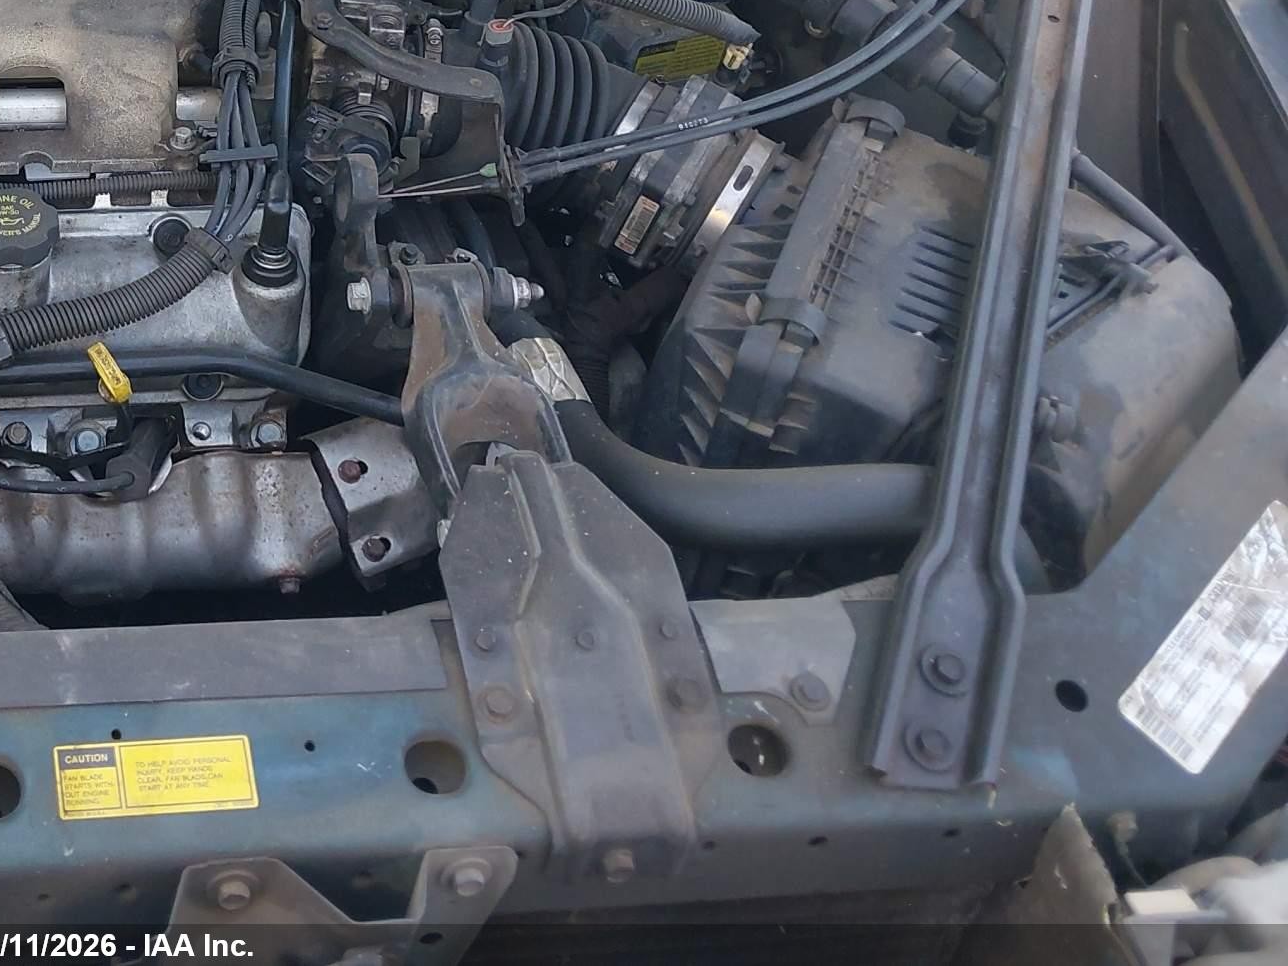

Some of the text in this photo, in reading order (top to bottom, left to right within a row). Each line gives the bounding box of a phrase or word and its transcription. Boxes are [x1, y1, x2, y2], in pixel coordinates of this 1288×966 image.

[19, 198, 35, 210] OIL
[21, 212, 41, 234] MANUAL
[64, 754, 109, 764] CAUTION
[135, 761, 146, 769] TO
[148, 760, 166, 768] HELP
[63, 774, 78, 782] FAN
